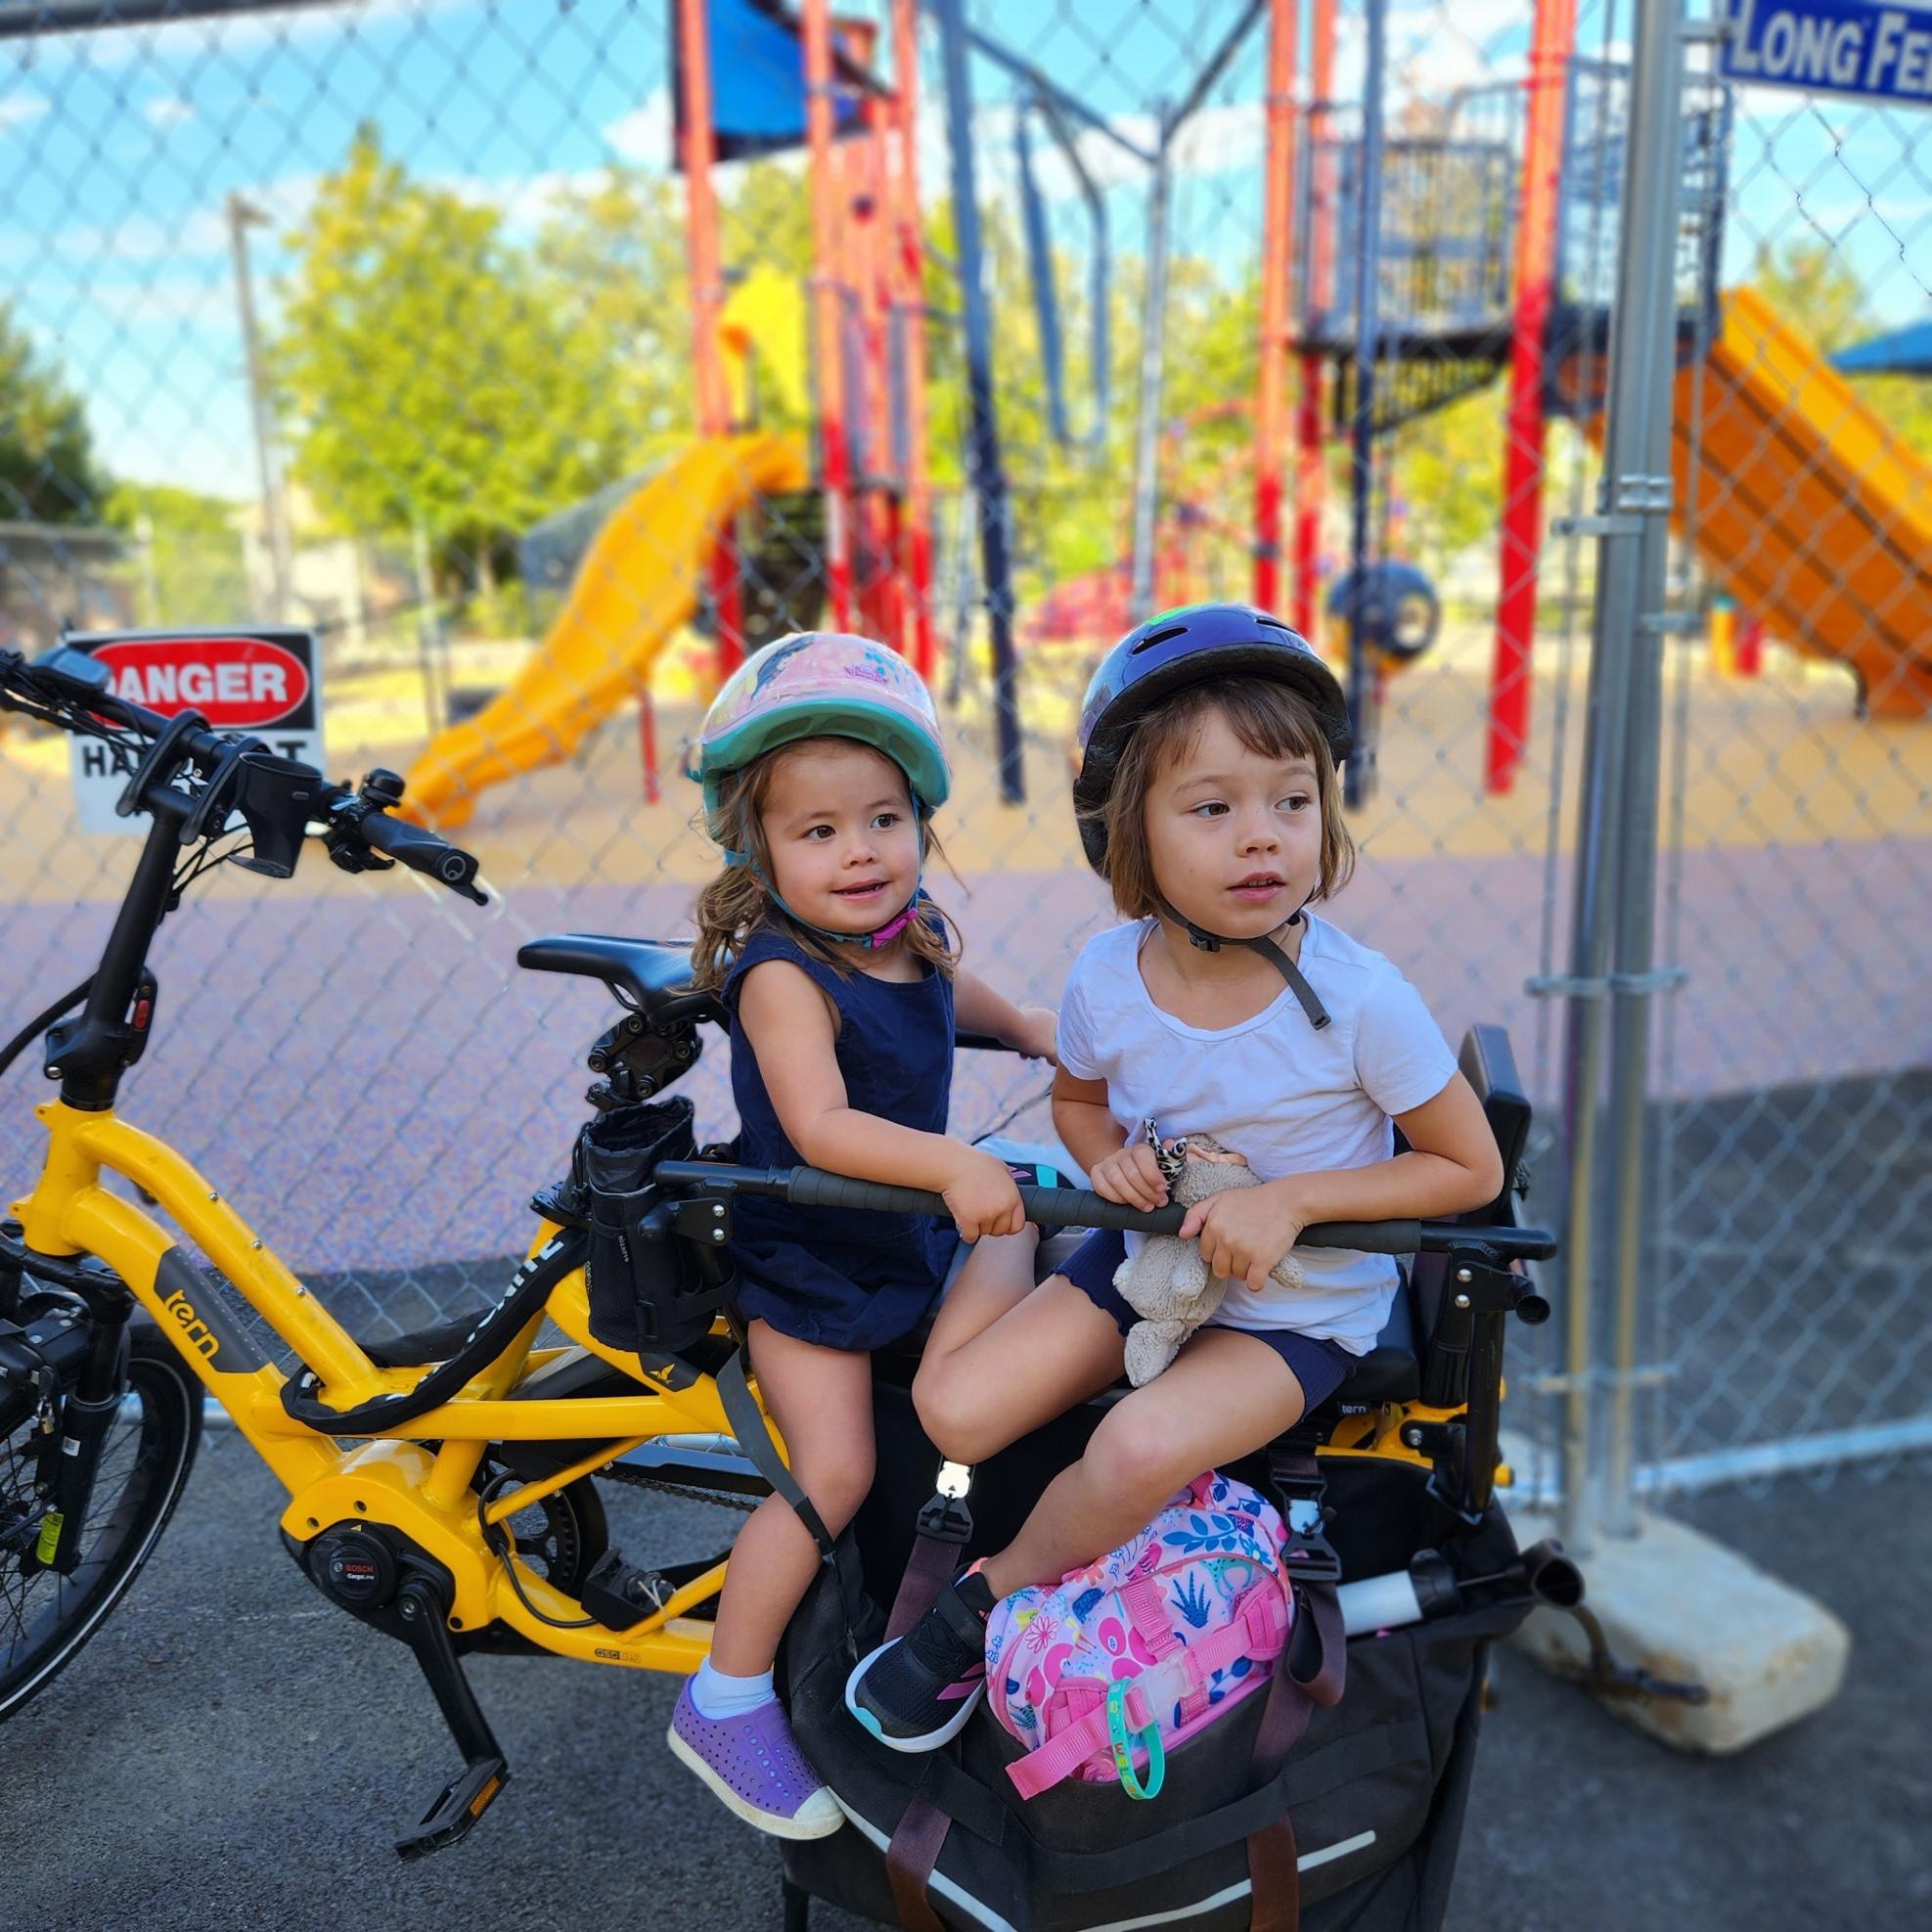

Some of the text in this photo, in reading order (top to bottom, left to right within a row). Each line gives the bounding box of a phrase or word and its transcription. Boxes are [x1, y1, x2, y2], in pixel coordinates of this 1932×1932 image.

[1730, 0, 1863, 85] LONG
[105, 661, 289, 704] ANGER
[164, 1289, 220, 1361] tern
[1341, 1404, 1367, 1415] tern
[345, 1564, 375, 1573] BOSCH
